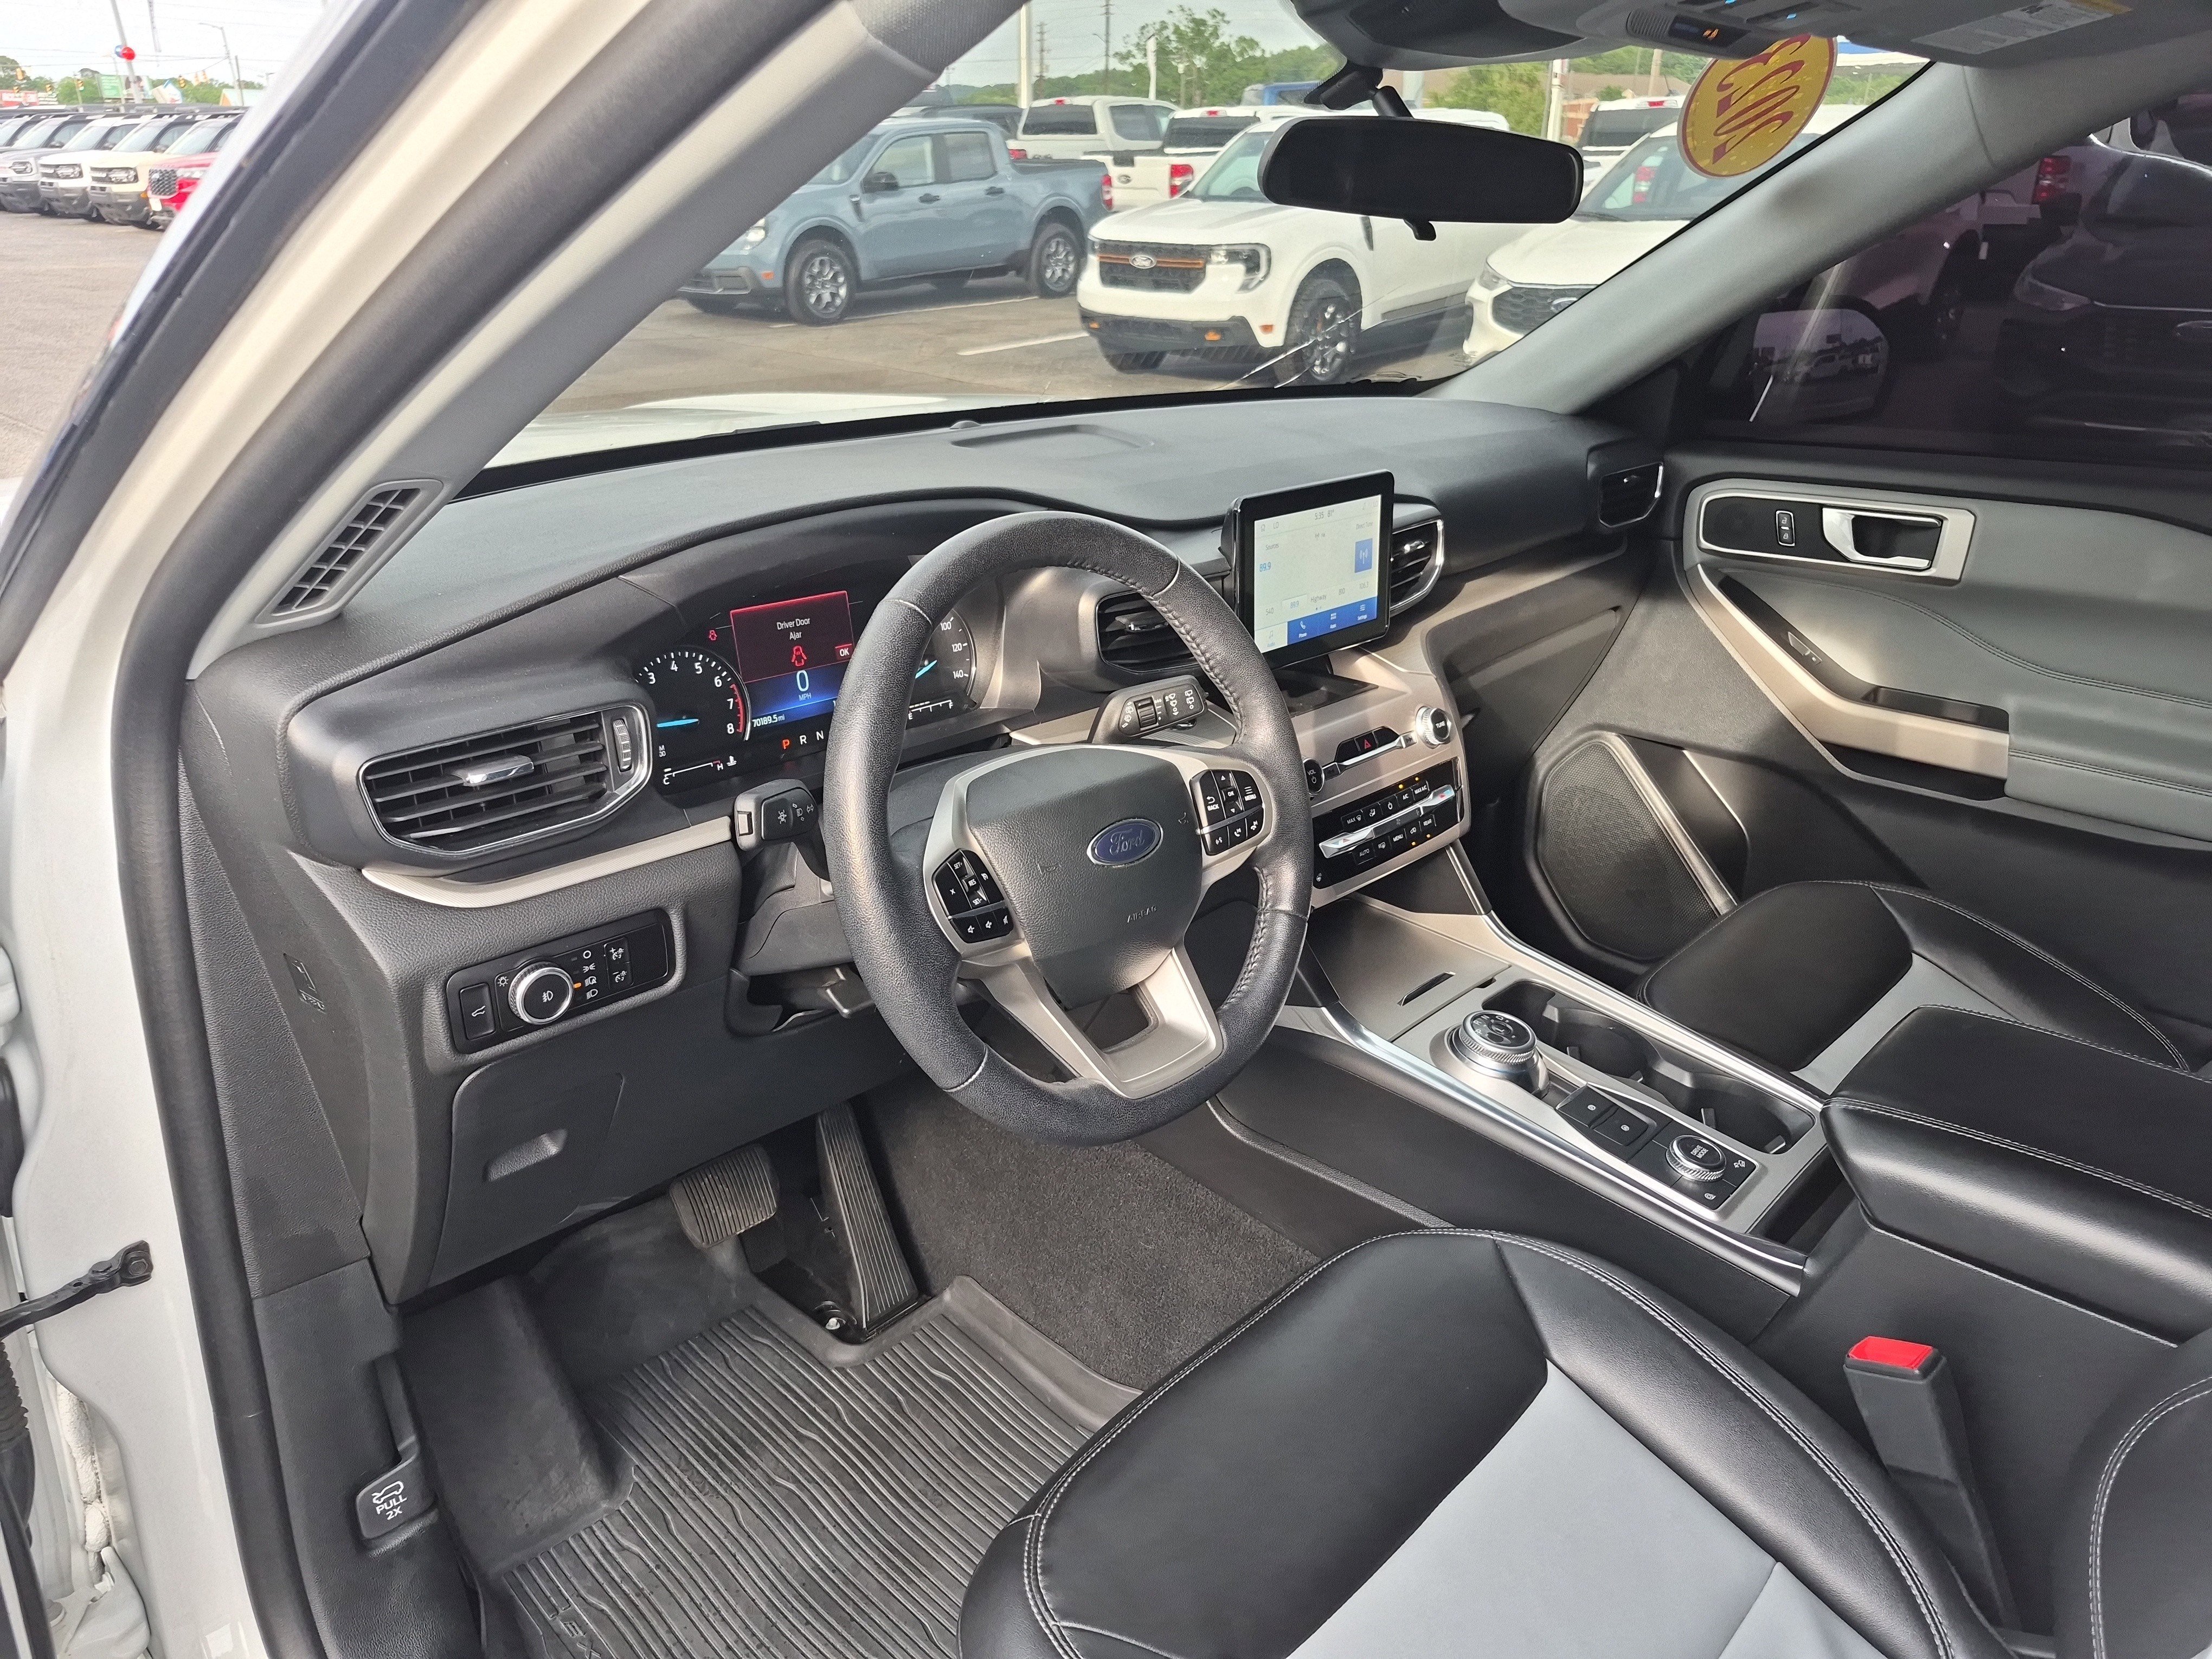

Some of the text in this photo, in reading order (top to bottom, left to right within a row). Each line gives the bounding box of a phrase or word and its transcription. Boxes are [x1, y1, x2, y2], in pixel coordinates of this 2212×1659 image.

[1315, 511, 1324, 520] 5:35
[1259, 562, 1271, 572] 89.9
[1290, 600, 1299, 609] 89.9
[1265, 607, 1274, 616] 540
[776, 618, 811, 630] Driver Door
[940, 621, 951, 631] 100
[789, 631, 802, 641] Ajar
[951, 642, 962, 652] 120
[839, 648, 850, 657] OK
[670, 660, 678, 672] 4
[695, 662, 703, 674] 5
[648, 672, 655, 684] 3
[953, 670, 963, 679] 140
[714, 676, 722, 687] 6
[796, 670, 809, 692] 0
[799, 692, 812, 702] MPH
[726, 698, 734, 710] 7
[726, 723, 735, 734] 8
[799, 735, 807, 745] R
[816, 730, 824, 741] N
[782, 739, 790, 750] P
[663, 777, 670, 785] C
[1423, 819, 1432, 827] REAR
[1109, 828, 1145, 856] Ford
[1393, 834, 1403, 842] MENU
[1359, 848, 1369, 857] AUTO
[968, 878, 976, 887] RES
[1127, 905, 1158, 923] AIRBAG
[1690, 1144, 1703, 1156] DRIVE
[1696, 1147, 1709, 1159] MODE
[375, 1494, 408, 1515] PULL
[386, 1506, 403, 1520] 2X
